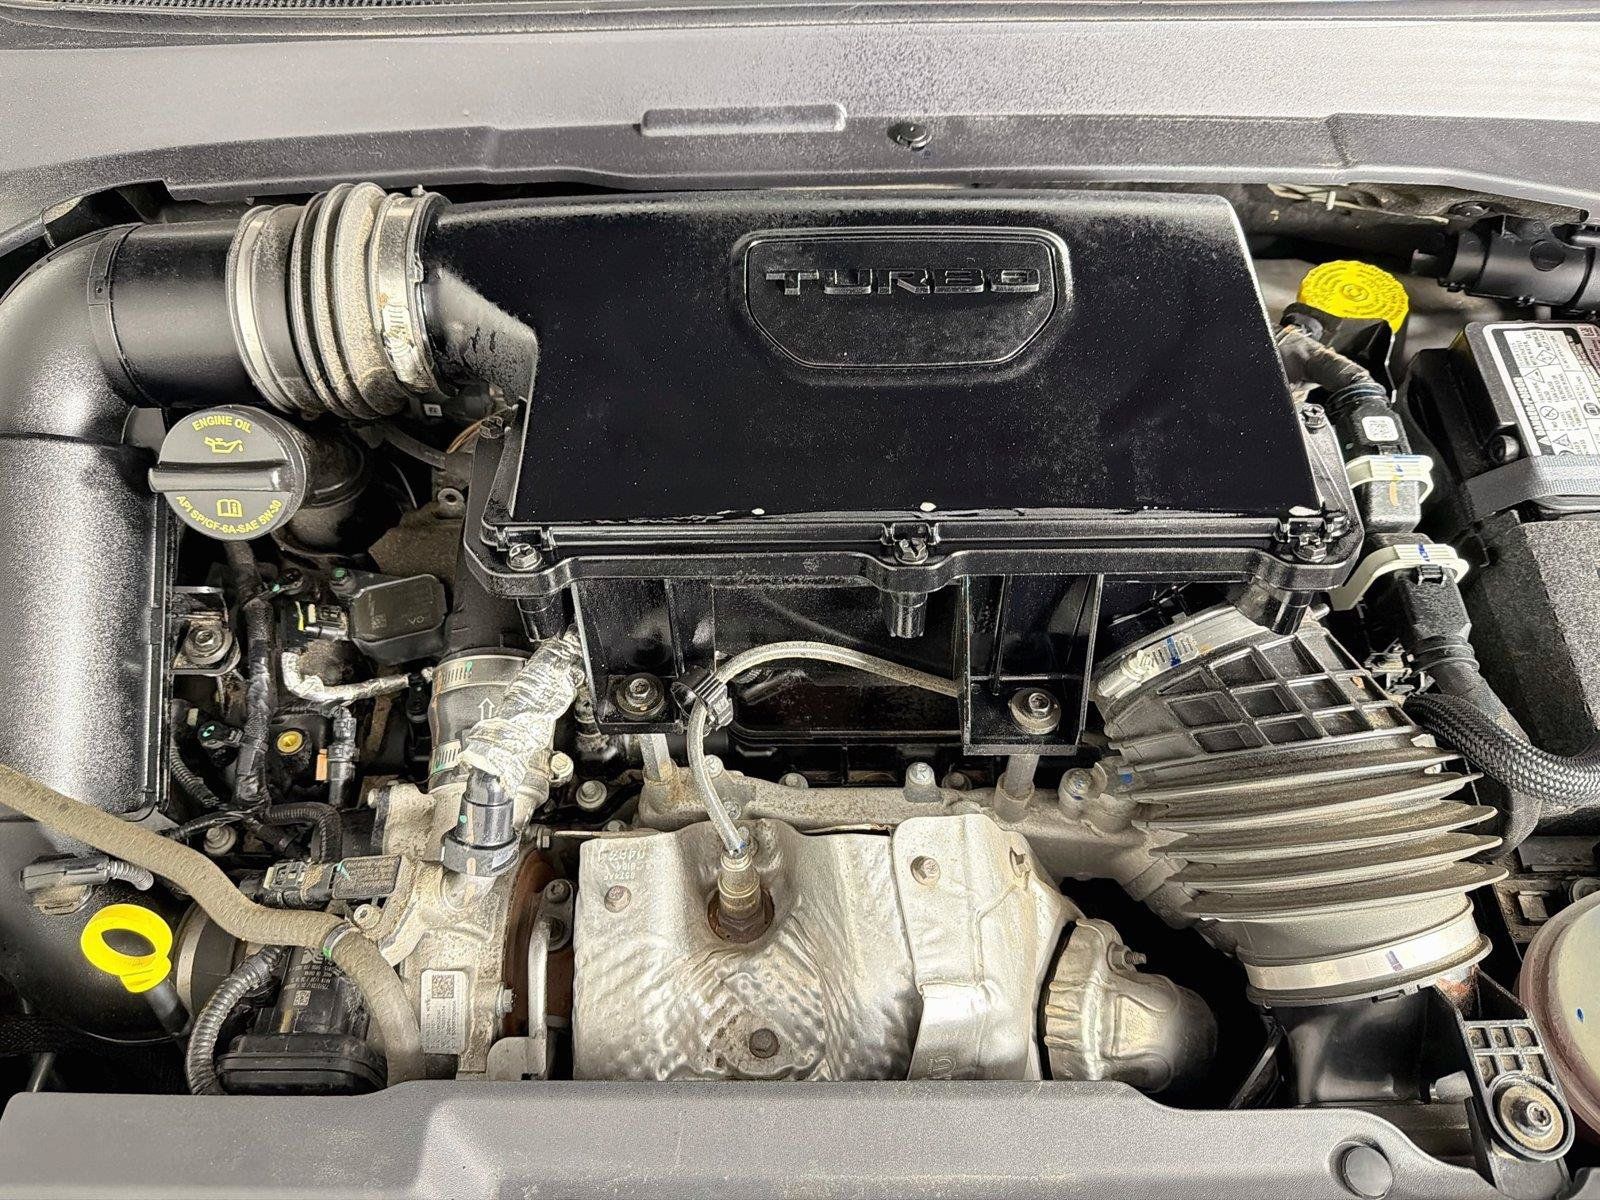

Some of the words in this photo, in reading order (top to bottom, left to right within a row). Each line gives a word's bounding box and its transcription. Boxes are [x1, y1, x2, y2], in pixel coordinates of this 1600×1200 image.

[765, 268, 1040, 296] TURBO
[192, 415, 233, 431] ENGINE
[234, 418, 251, 434] OIL
[176, 495, 194, 513] API
[258, 499, 282, 525] 5W-30
